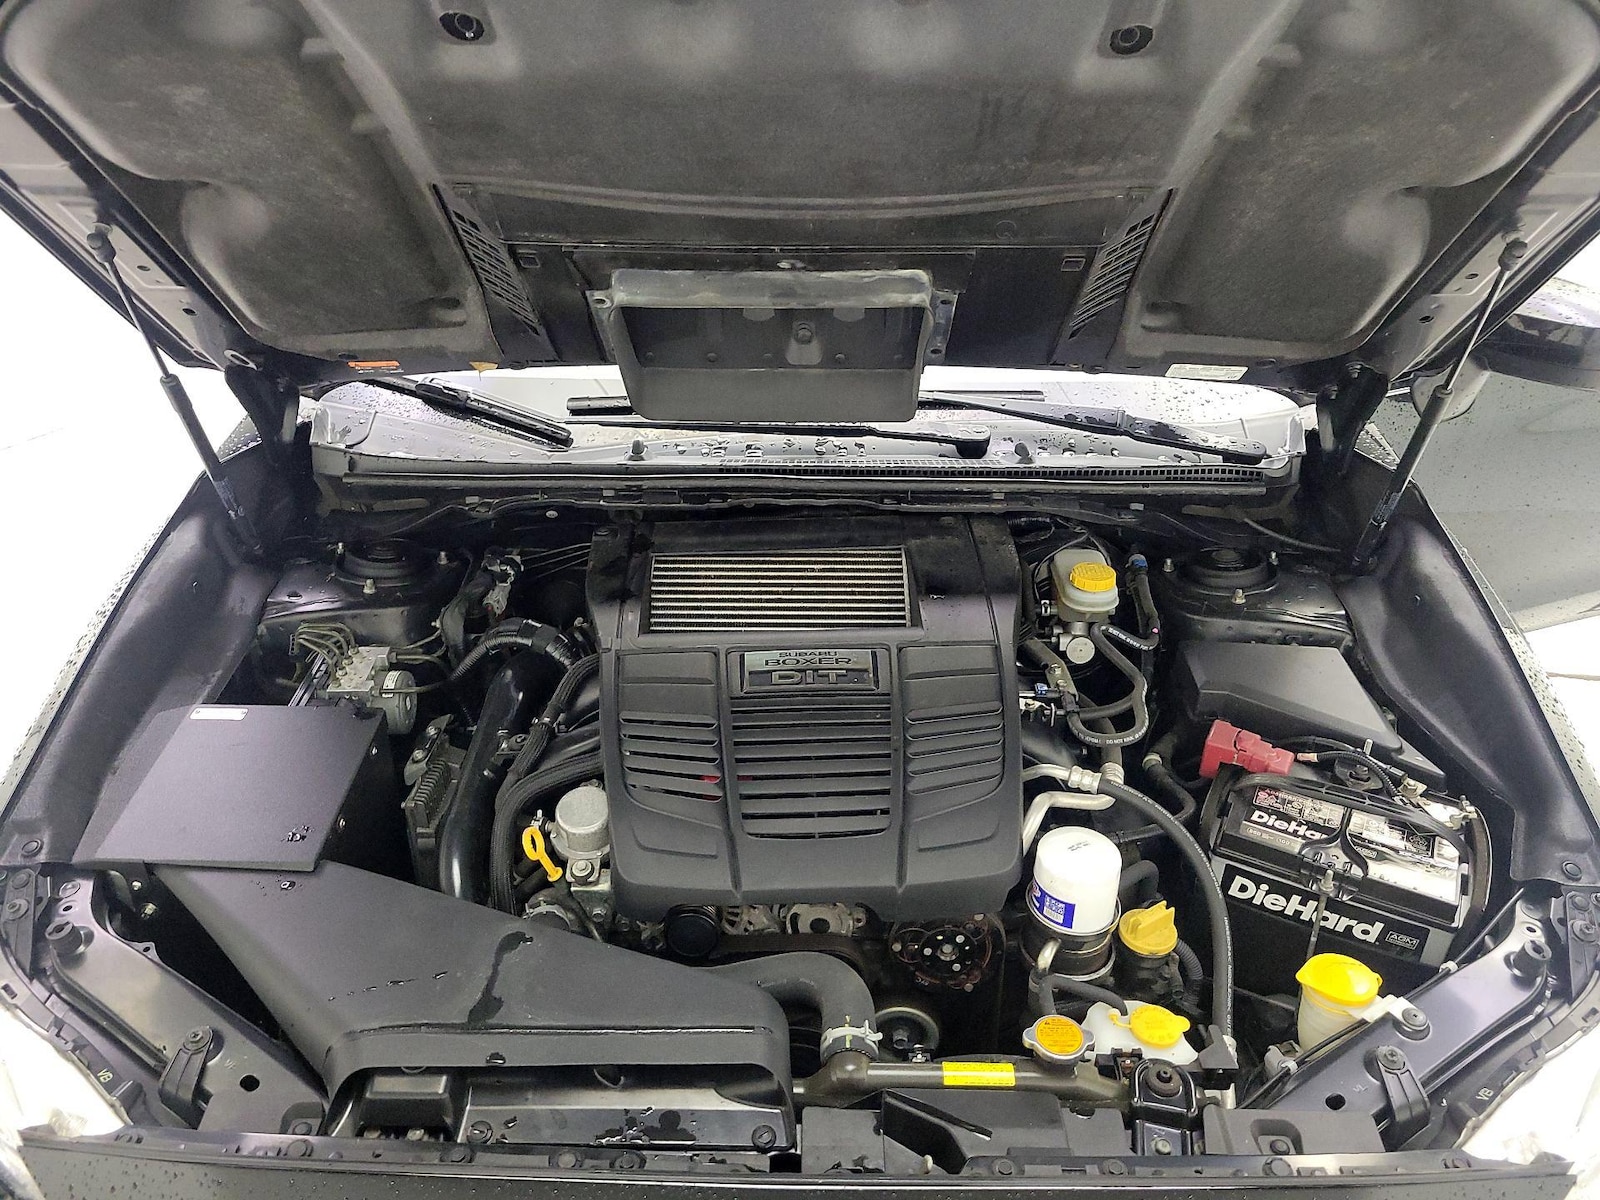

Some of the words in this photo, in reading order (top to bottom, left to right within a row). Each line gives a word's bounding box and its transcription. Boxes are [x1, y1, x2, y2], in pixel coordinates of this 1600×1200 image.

[765, 657, 852, 667] BOXER
[771, 670, 848, 685] DIT
[1228, 875, 1385, 944] DieHard
[1389, 932, 1417, 946] AGM
[96, 1068, 114, 1083] VB
[1475, 1086, 1495, 1101] VB
